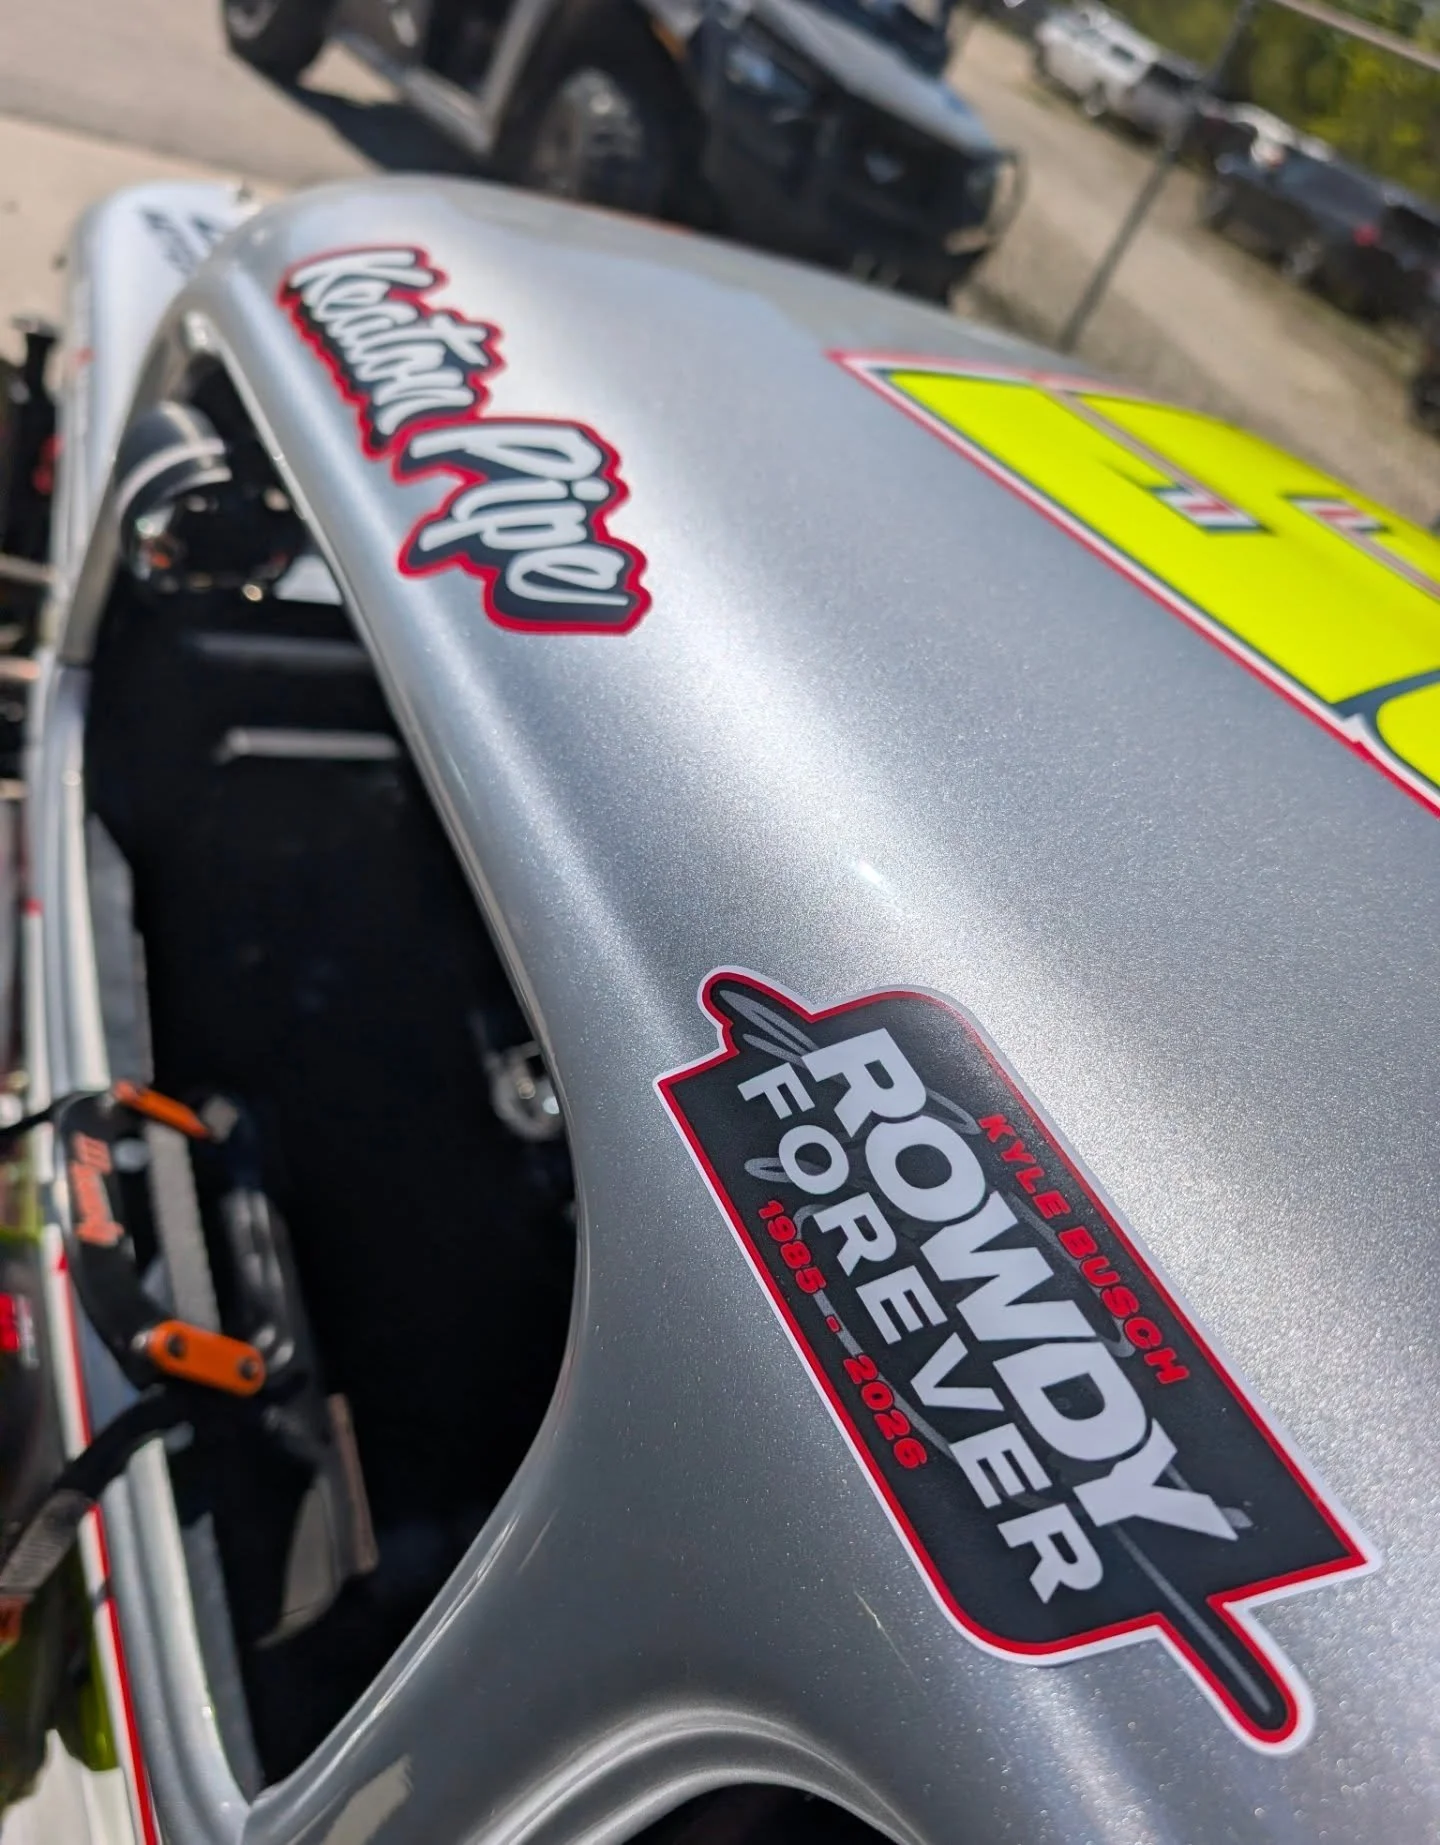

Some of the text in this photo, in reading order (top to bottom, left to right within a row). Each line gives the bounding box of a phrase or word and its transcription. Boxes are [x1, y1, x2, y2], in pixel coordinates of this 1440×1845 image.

[286, 247, 630, 607] Keaton Pipe
[736, 1062, 1105, 1604] FOREVER
[757, 1199, 827, 1296] 1985
[842, 1354, 929, 1470] 2026
[800, 1027, 1239, 1542] ROWDY
[978, 1113, 1190, 1386] KYLE BUSCH
